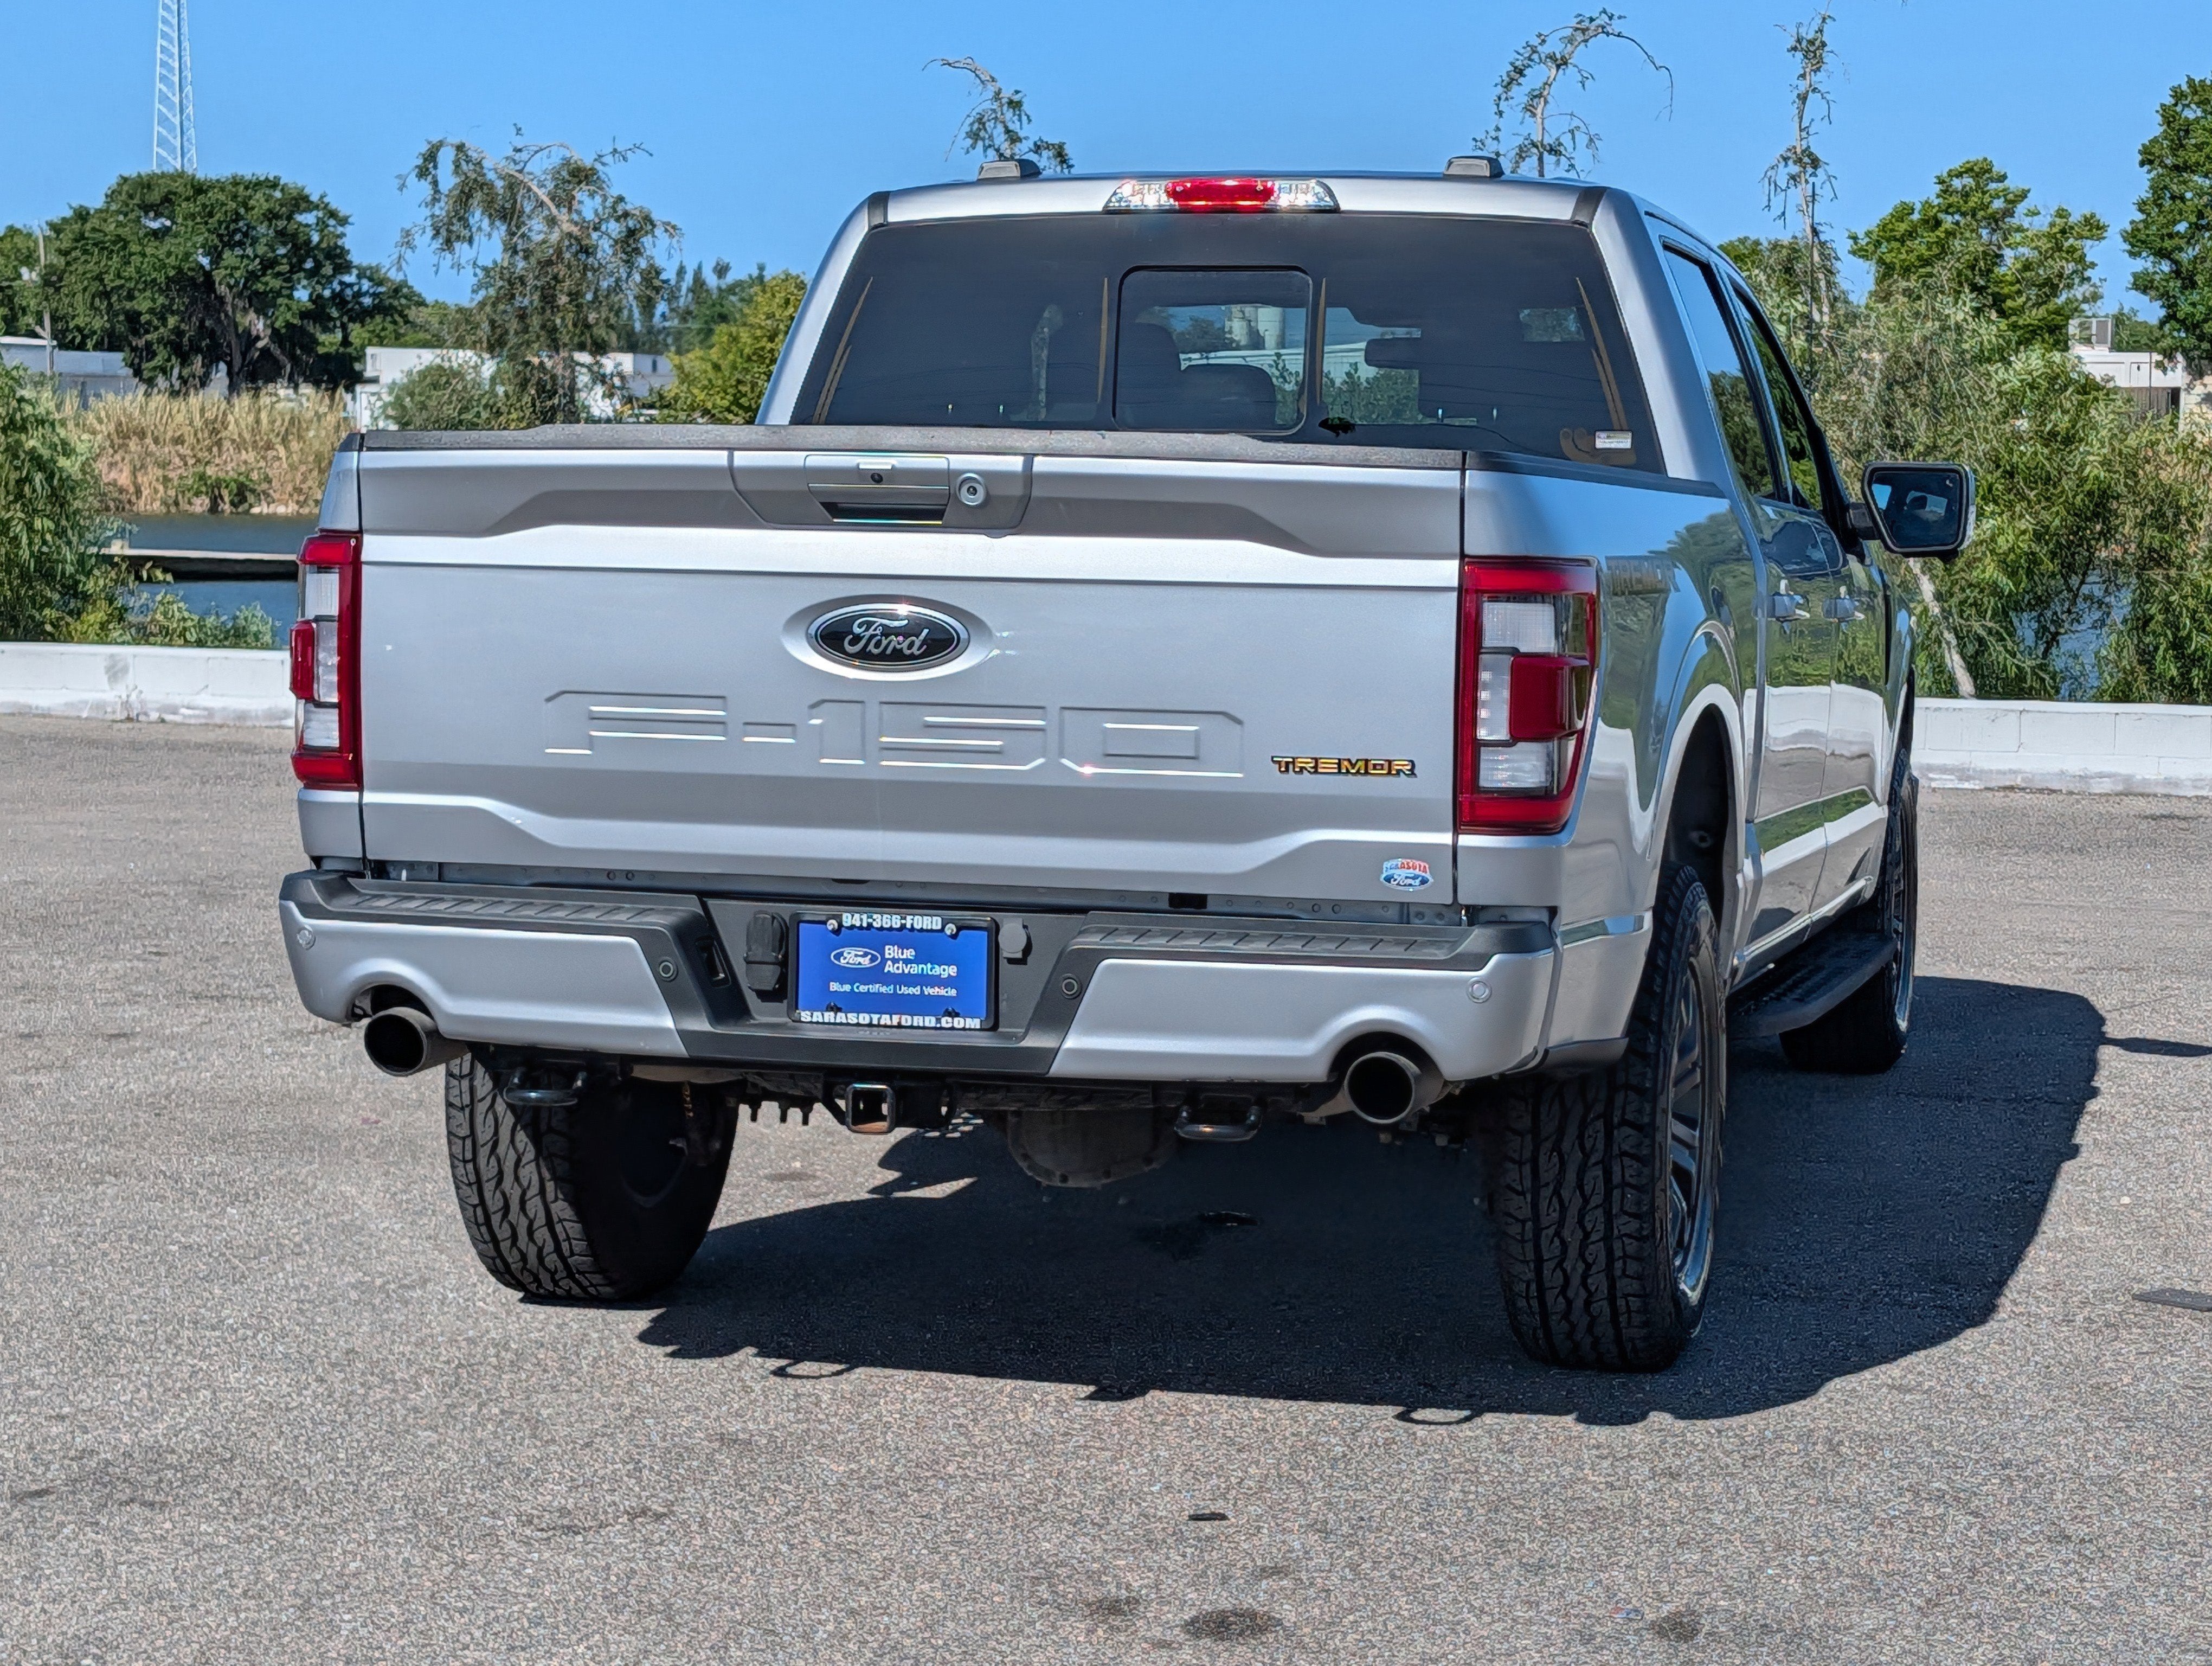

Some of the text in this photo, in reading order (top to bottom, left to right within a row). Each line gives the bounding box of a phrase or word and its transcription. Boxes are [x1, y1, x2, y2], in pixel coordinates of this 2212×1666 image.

[844, 617, 929, 656] Ford
[545, 690, 1244, 777] F-150
[1271, 756, 1416, 778] TREMOR
[1390, 873, 1423, 886] Ford
[842, 913, 942, 930] 941-366-FORD
[840, 950, 872, 965] Ford
[884, 945, 916, 959] Blue
[884, 960, 958, 978] Advantage
[829, 982, 957, 997] Blue Certified Used Vehicle
[800, 1011, 981, 1029] SARASOTAFORD.COM
